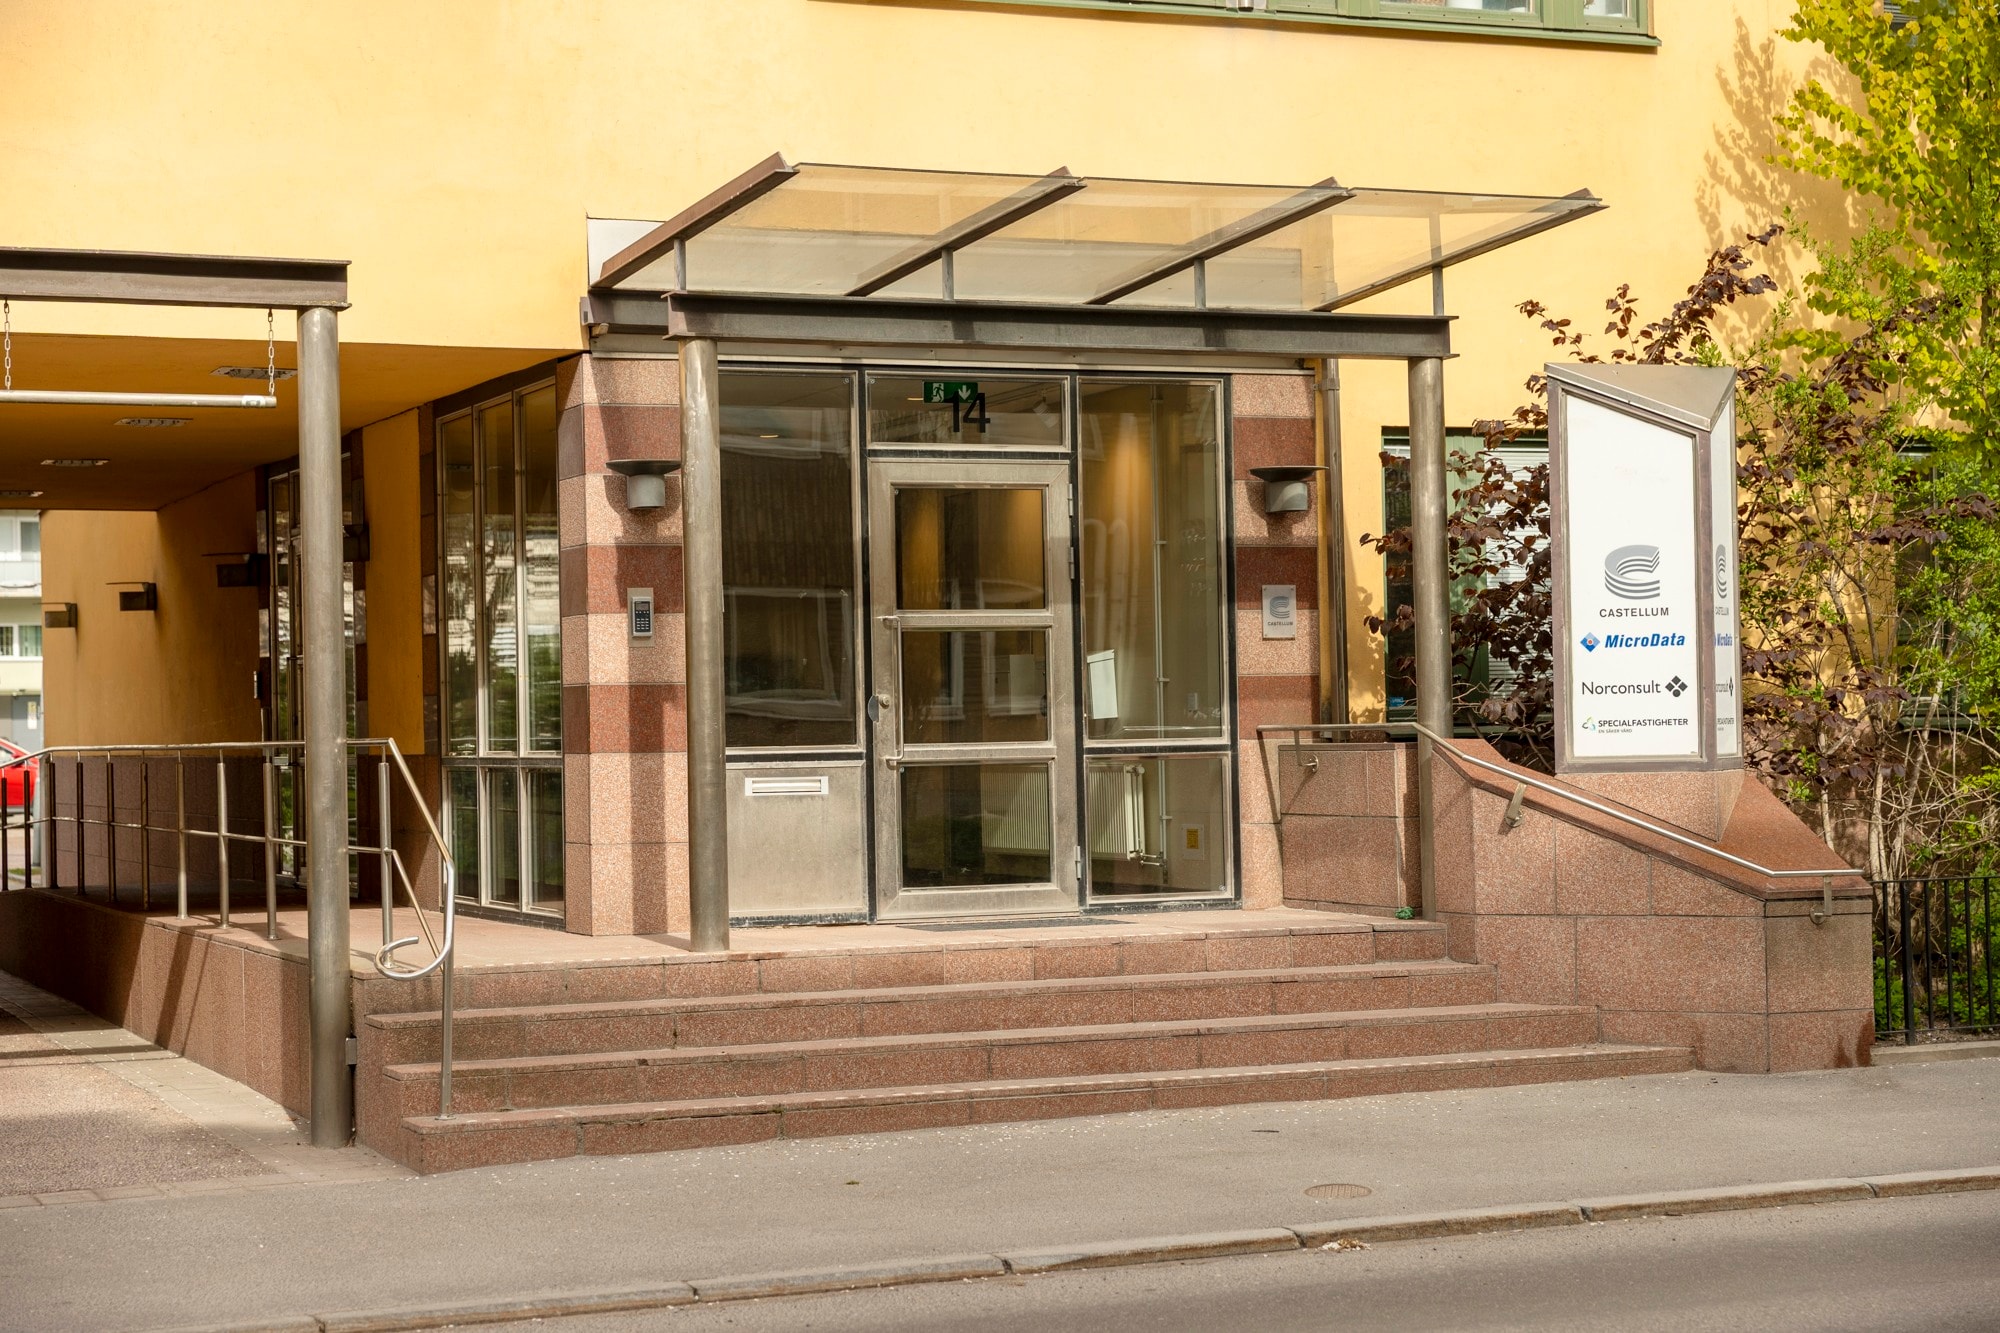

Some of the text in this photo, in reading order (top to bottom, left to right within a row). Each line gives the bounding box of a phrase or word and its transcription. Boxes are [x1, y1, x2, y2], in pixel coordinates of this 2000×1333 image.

[944, 391, 991, 433] 14
[1599, 607, 1670, 618] CASTELLUM
[1604, 633, 1685, 648] MicroData
[1581, 679, 1662, 695] Norconsult
[1598, 718, 1688, 727] SPECIALFASTIGHETER
